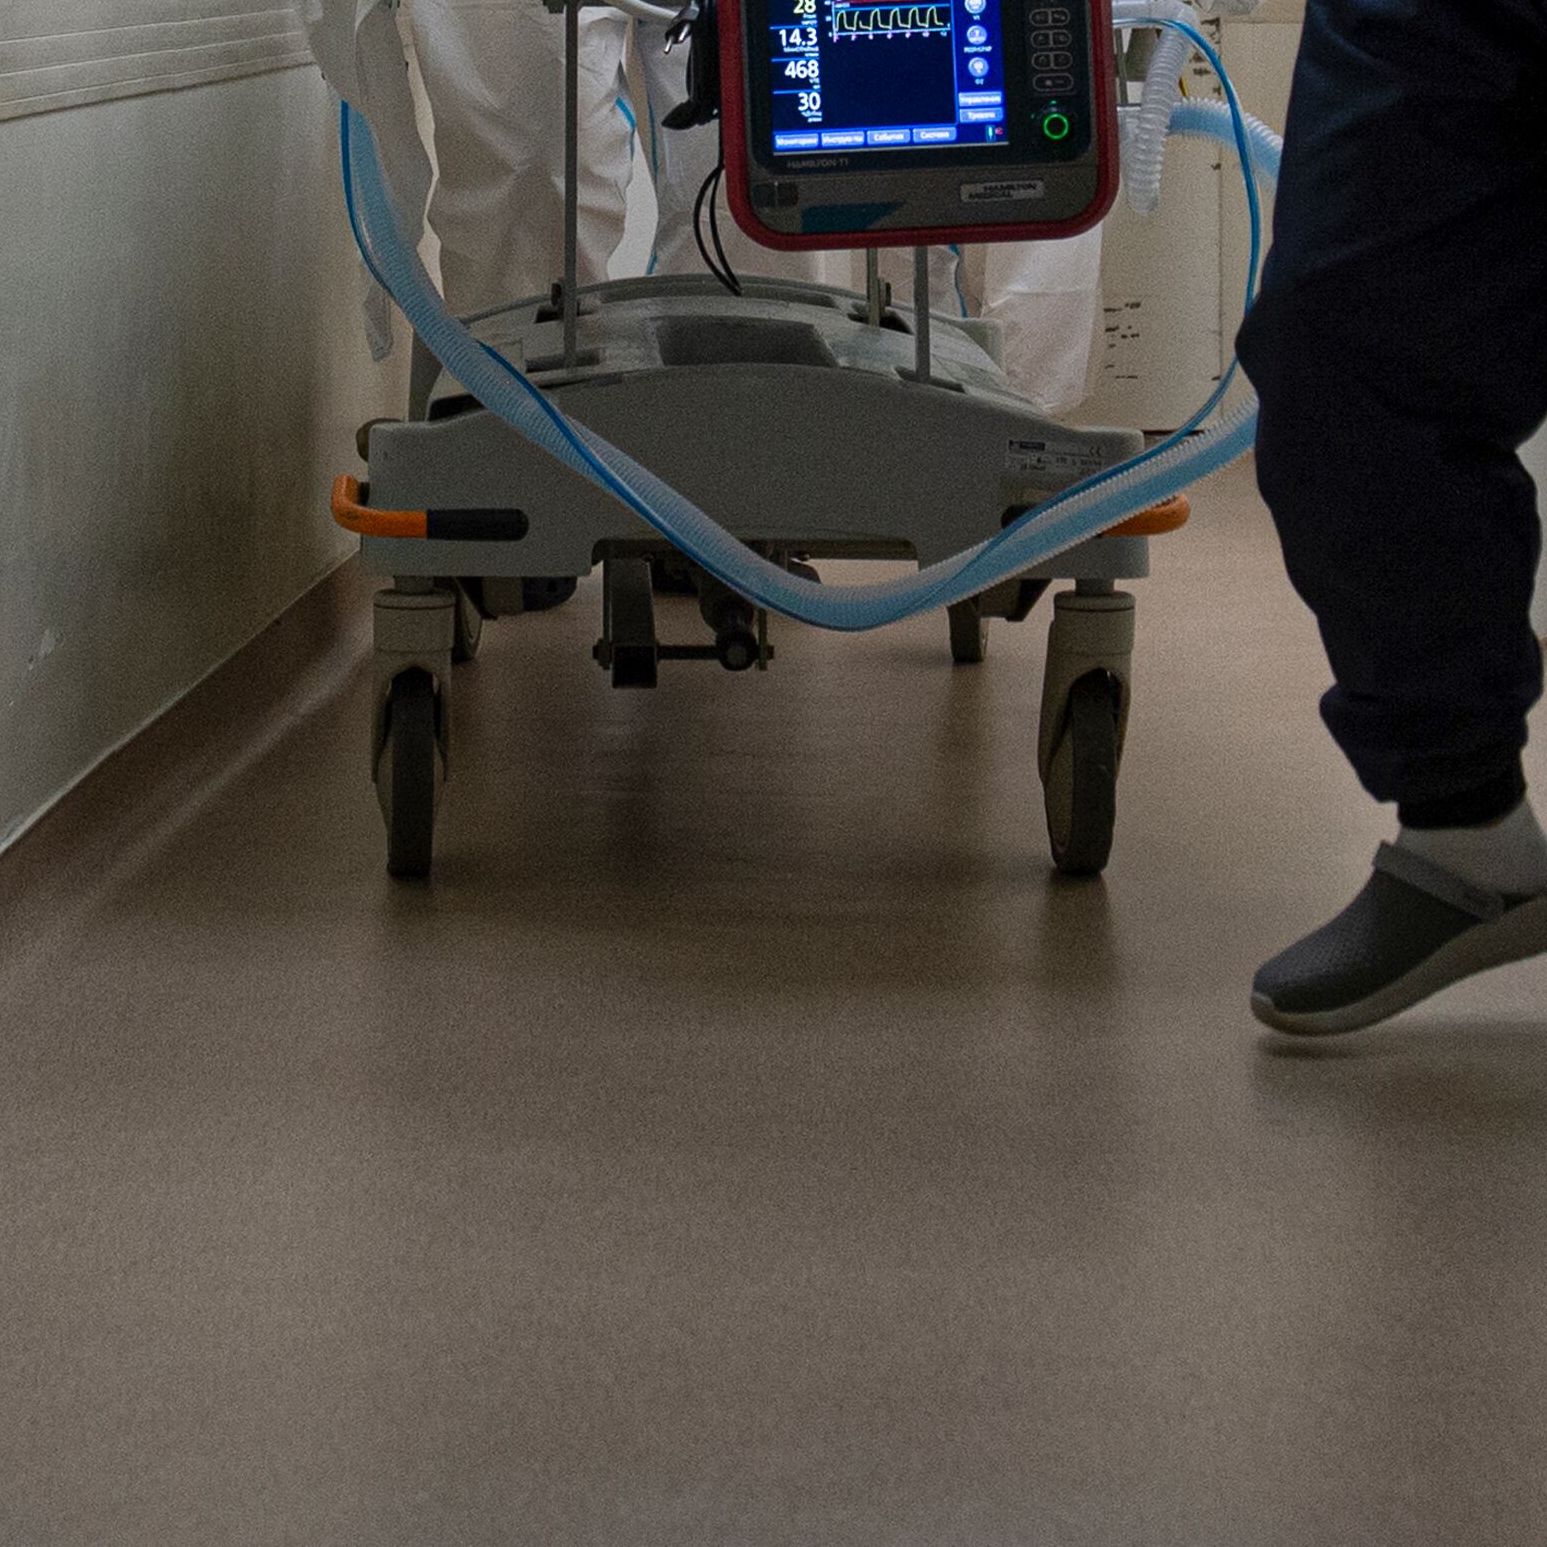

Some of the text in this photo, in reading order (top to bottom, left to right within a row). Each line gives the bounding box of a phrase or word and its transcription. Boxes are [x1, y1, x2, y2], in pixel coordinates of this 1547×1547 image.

[779, 27, 818, 46] 14.3
[784, 59, 820, 79] 468
[798, 92, 821, 111] 30
